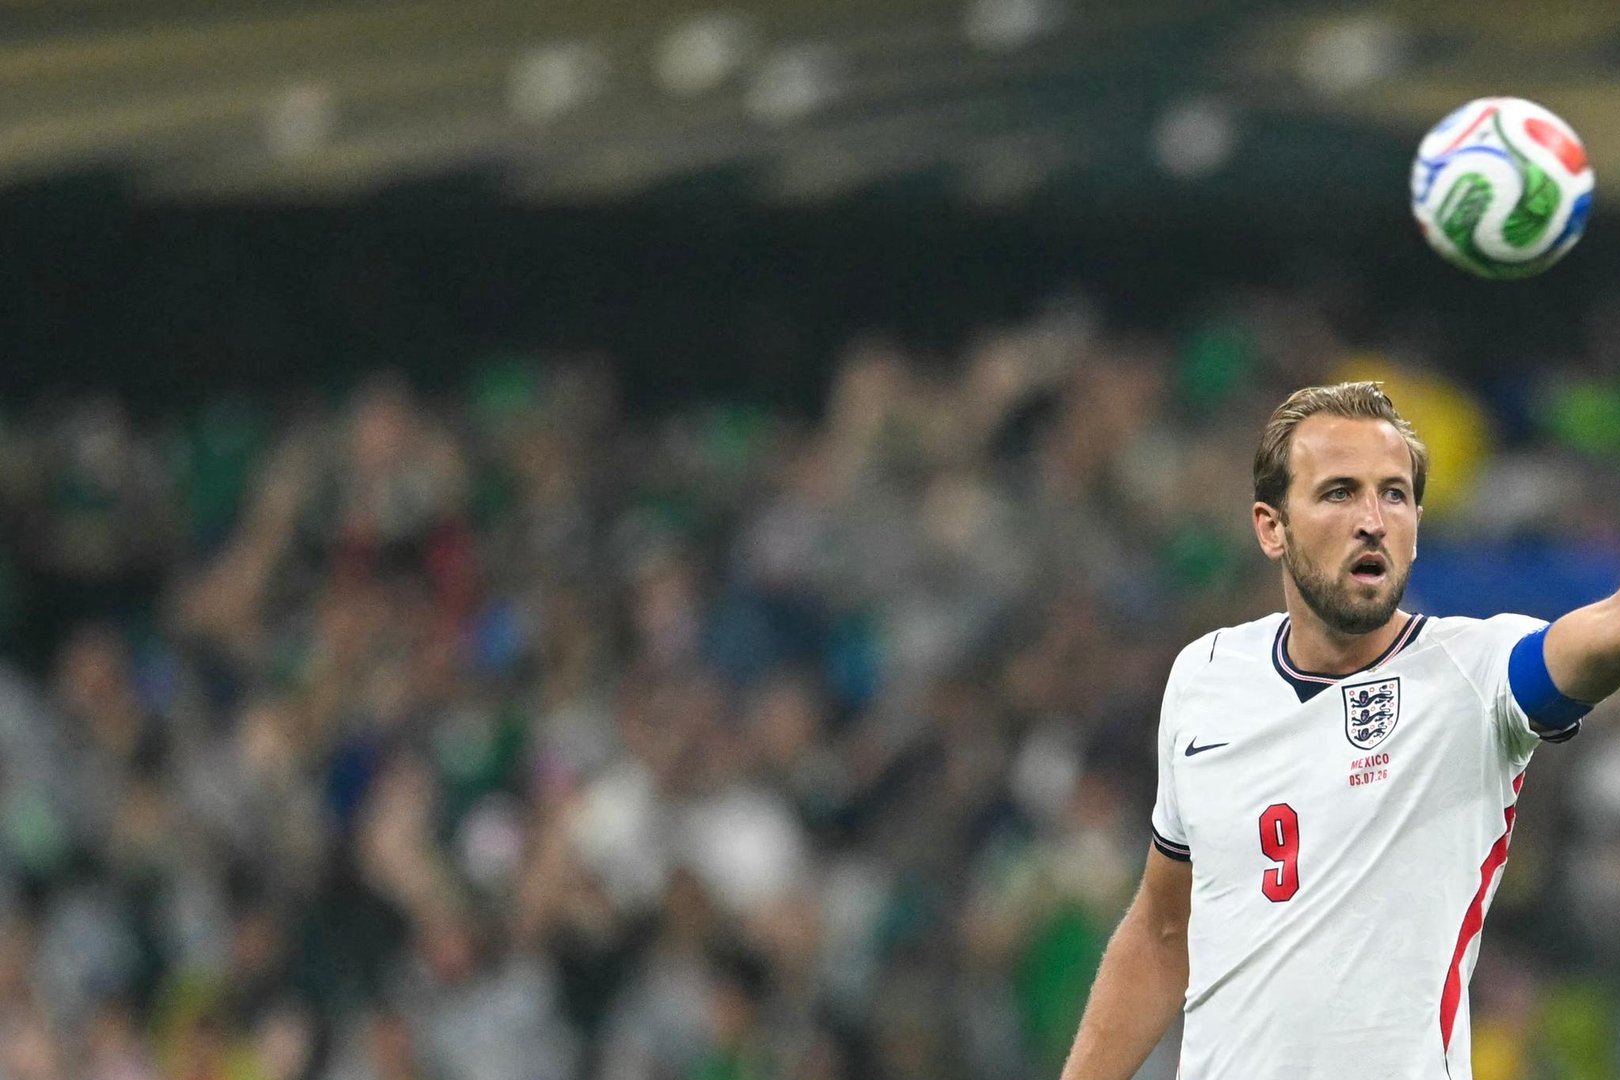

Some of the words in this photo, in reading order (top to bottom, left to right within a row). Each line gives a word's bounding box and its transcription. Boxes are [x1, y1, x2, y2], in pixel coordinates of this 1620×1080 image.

[1350, 753, 1389, 769] MEXICO
[1349, 769, 1388, 786] 05.07.26
[1259, 803, 1300, 902] 9
